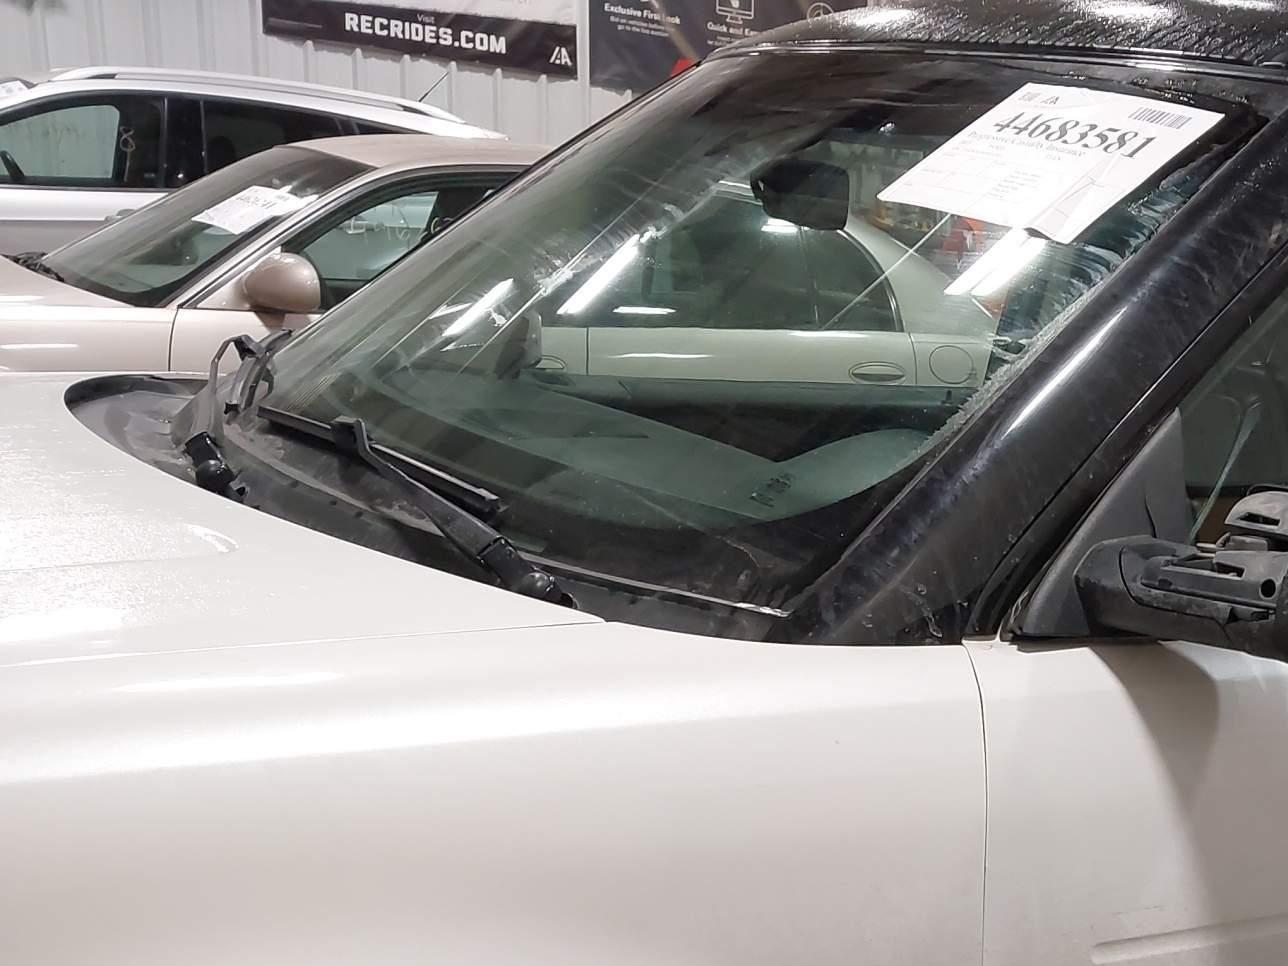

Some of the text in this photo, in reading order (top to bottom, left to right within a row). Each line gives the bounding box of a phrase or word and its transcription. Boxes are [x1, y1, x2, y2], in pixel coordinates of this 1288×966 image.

[604, 2, 642, 17] Exclusive
[416, 13, 435, 24] Visit
[344, 12, 506, 54] RECRIDES.COM
[707, 21, 728, 33] Quick
[993, 111, 1157, 158] 44683581
